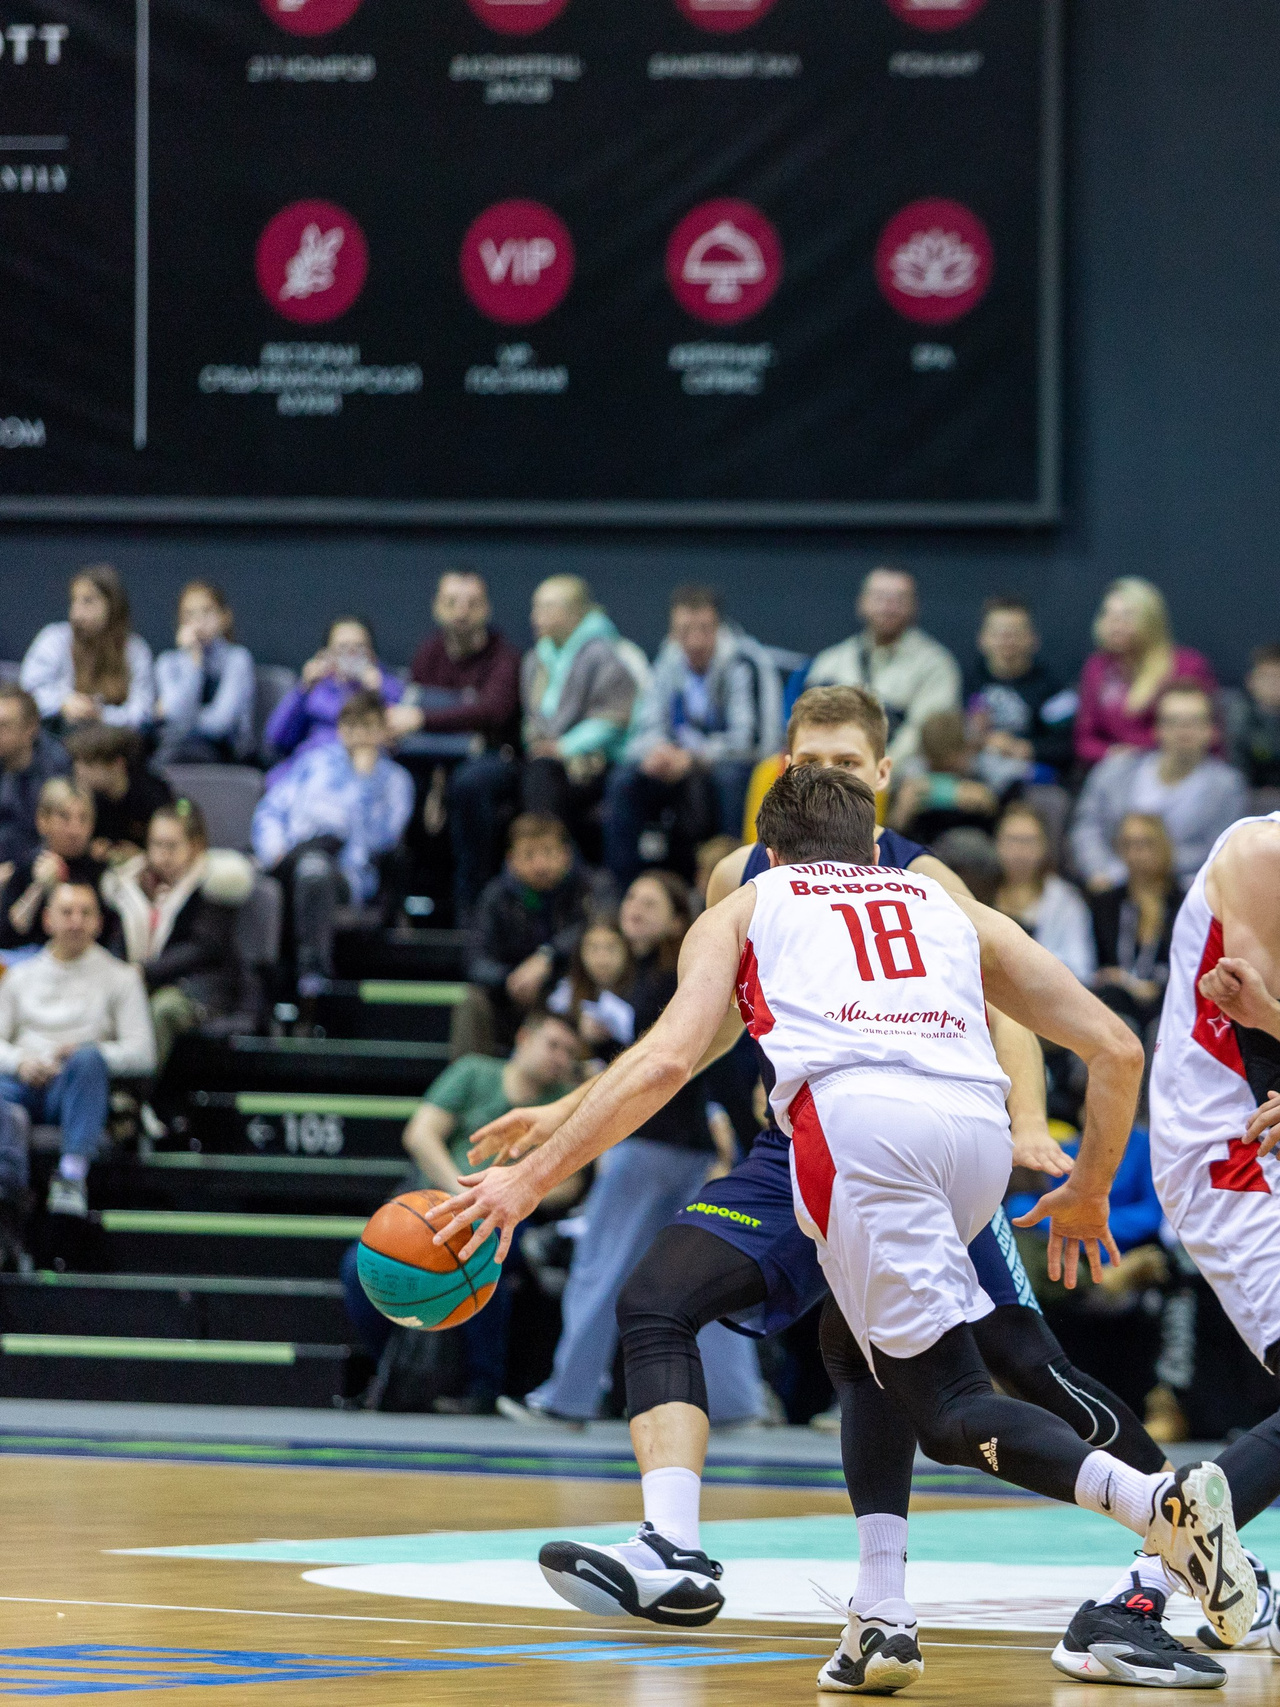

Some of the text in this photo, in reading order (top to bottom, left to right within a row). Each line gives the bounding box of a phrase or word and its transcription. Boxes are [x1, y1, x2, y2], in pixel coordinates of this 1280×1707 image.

[0, 24, 69, 65] TT
[479, 238, 556, 285] VIP
[789, 881, 927, 900] BetBoom
[830, 900, 927, 981] 18
